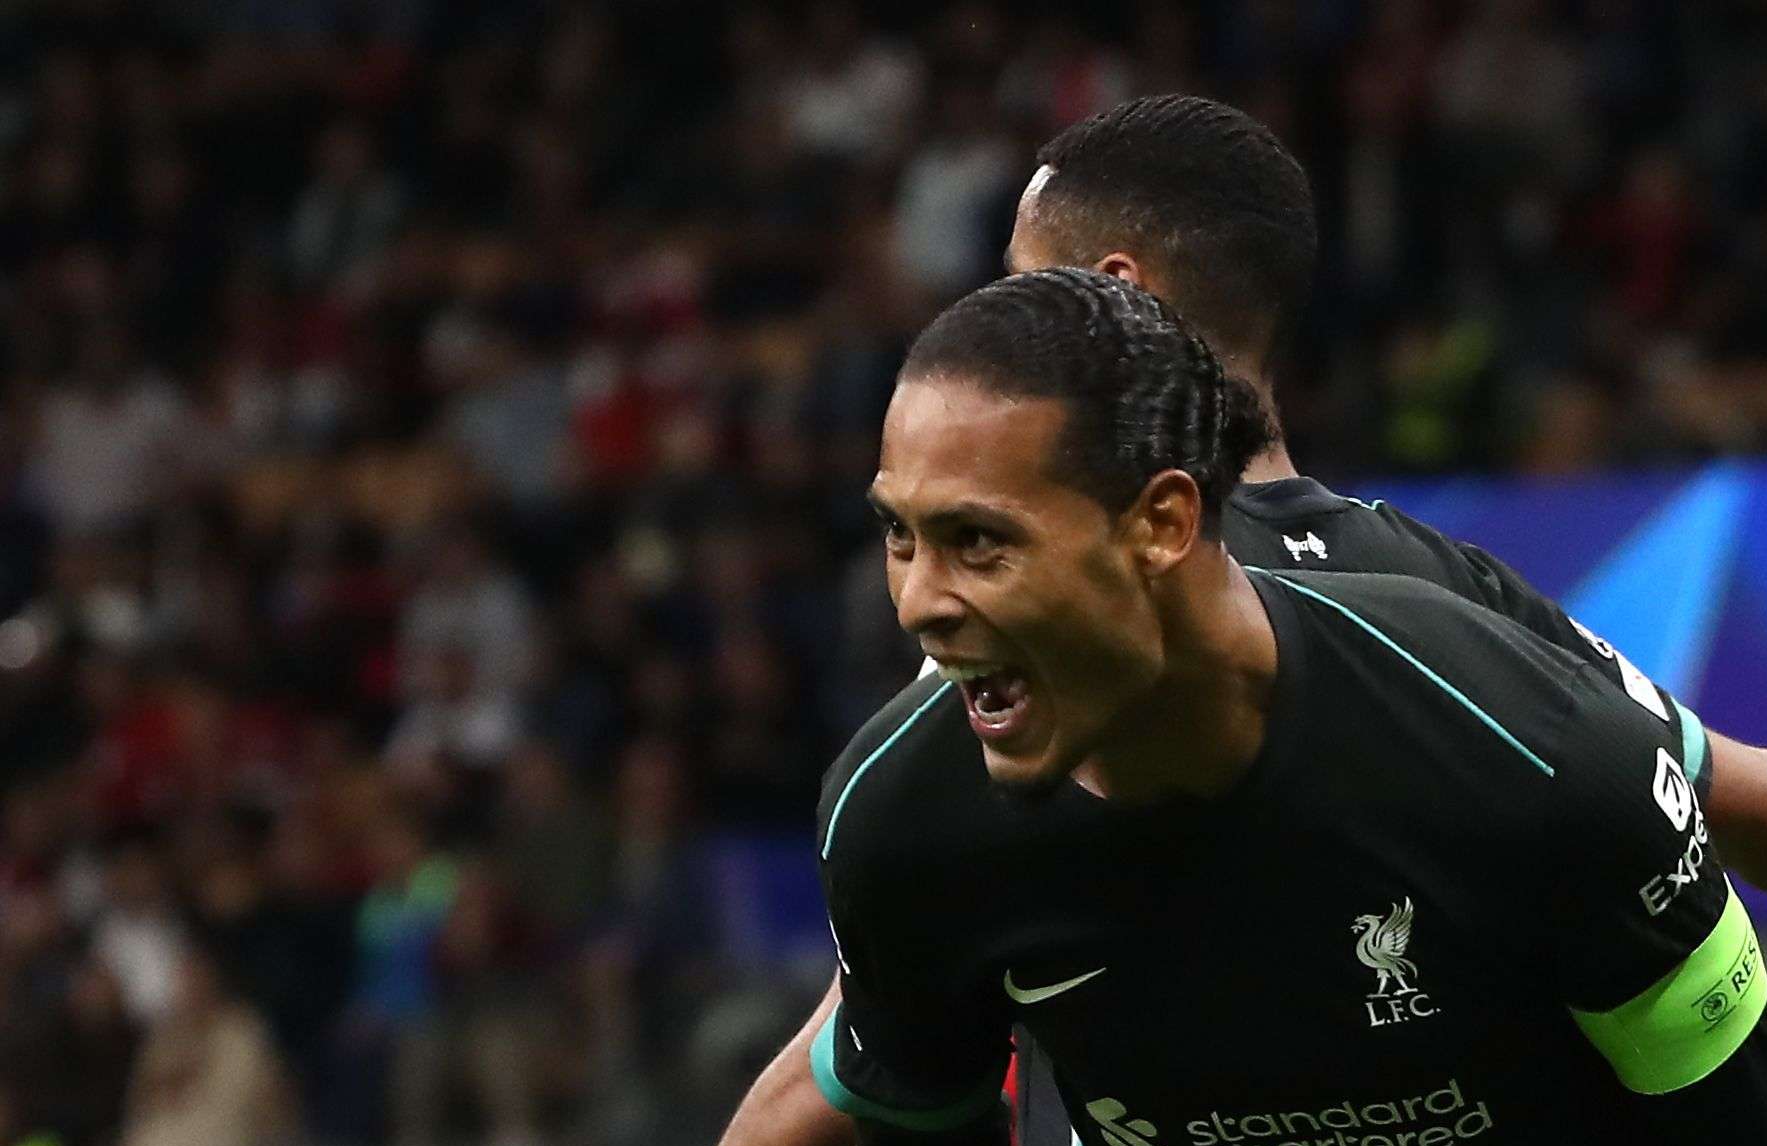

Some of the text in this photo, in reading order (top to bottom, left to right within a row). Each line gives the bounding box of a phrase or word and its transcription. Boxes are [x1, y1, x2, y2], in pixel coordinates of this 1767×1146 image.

[1731, 928, 1758, 993] RES
[1365, 994, 1441, 1028] L.F.C.
[1186, 1079, 1465, 1146] standard
